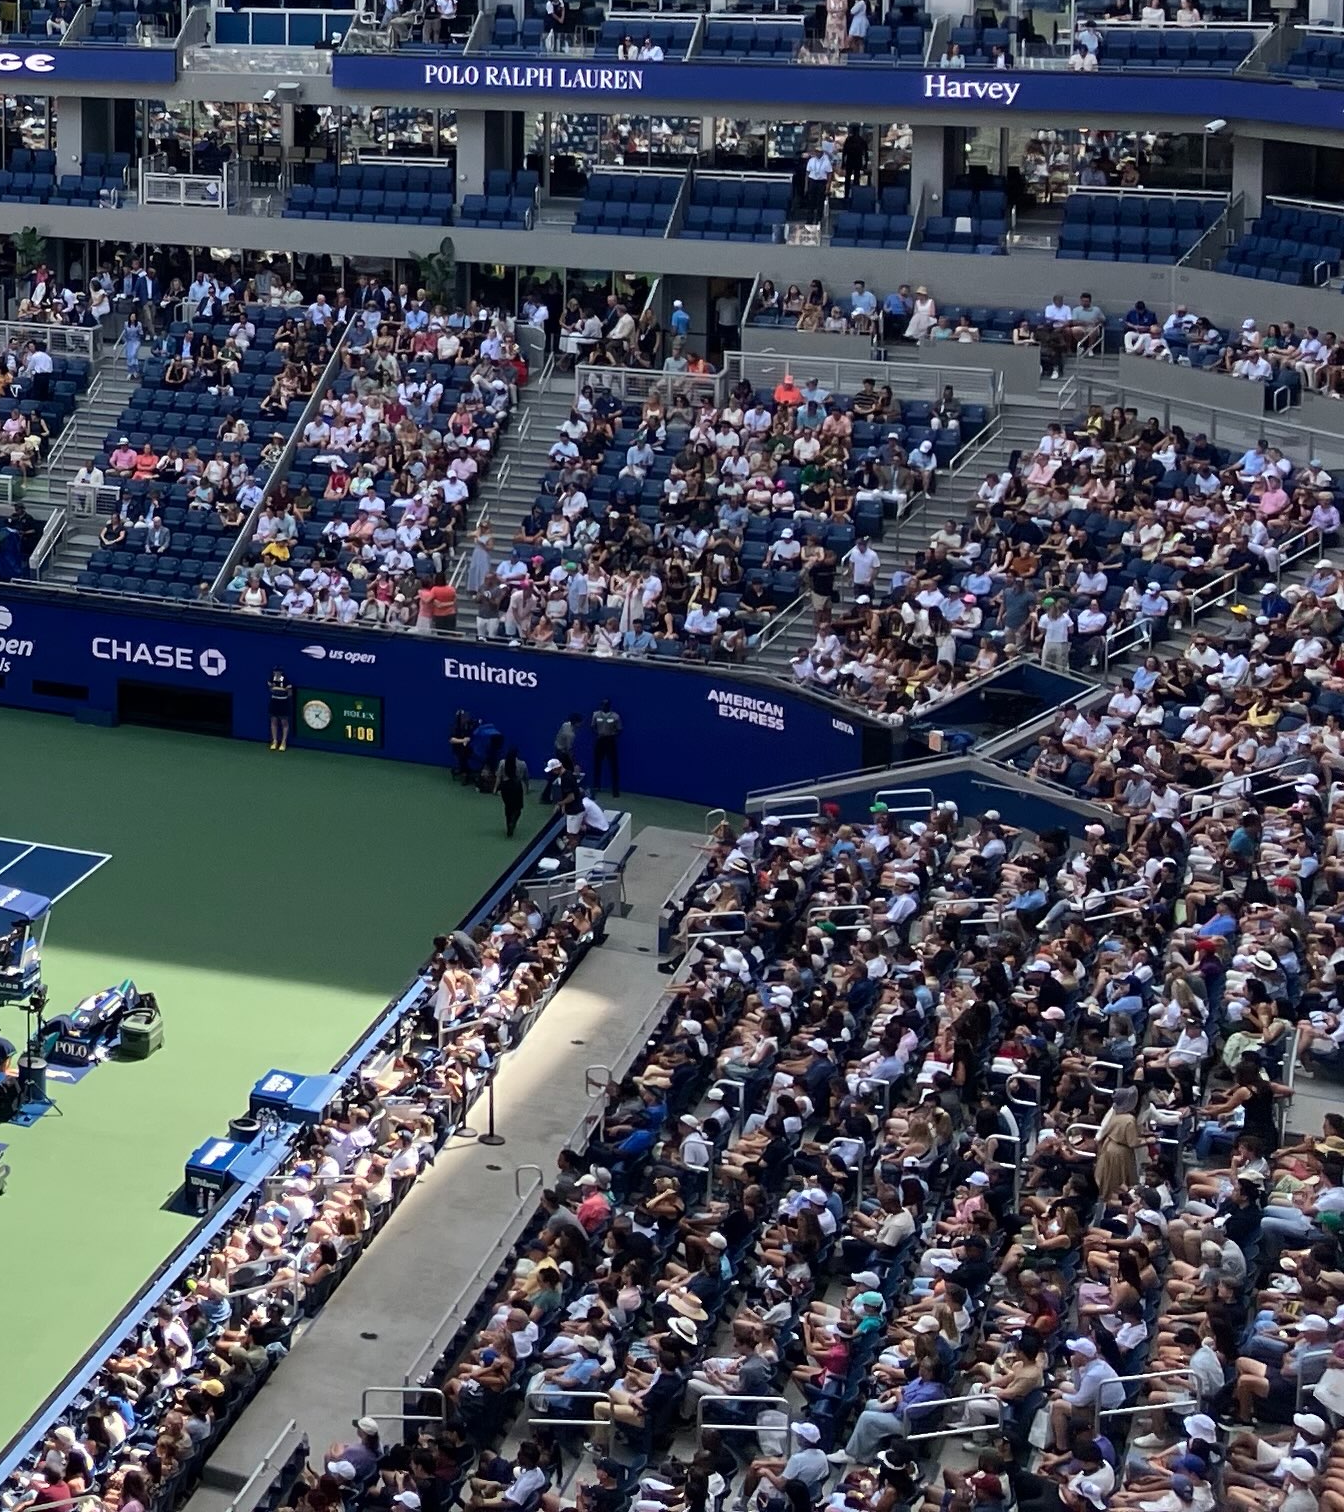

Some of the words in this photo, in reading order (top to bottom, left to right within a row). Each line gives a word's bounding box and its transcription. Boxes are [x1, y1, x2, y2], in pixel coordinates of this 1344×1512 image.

[424, 65, 479, 85] POLO
[485, 66, 553, 88] RALPH
[559, 68, 644, 90] LAUREN
[924, 75, 1020, 105] Harvey
[91, 637, 194, 670] CHASE
[329, 648, 343, 661] us
[344, 651, 376, 665] open
[444, 658, 538, 688] Emirates
[343, 710, 375, 721] ROLEX
[708, 689, 784, 718] AMERICAN
[719, 704, 785, 731] EXPRESS
[55, 1041, 87, 1058] POLO
